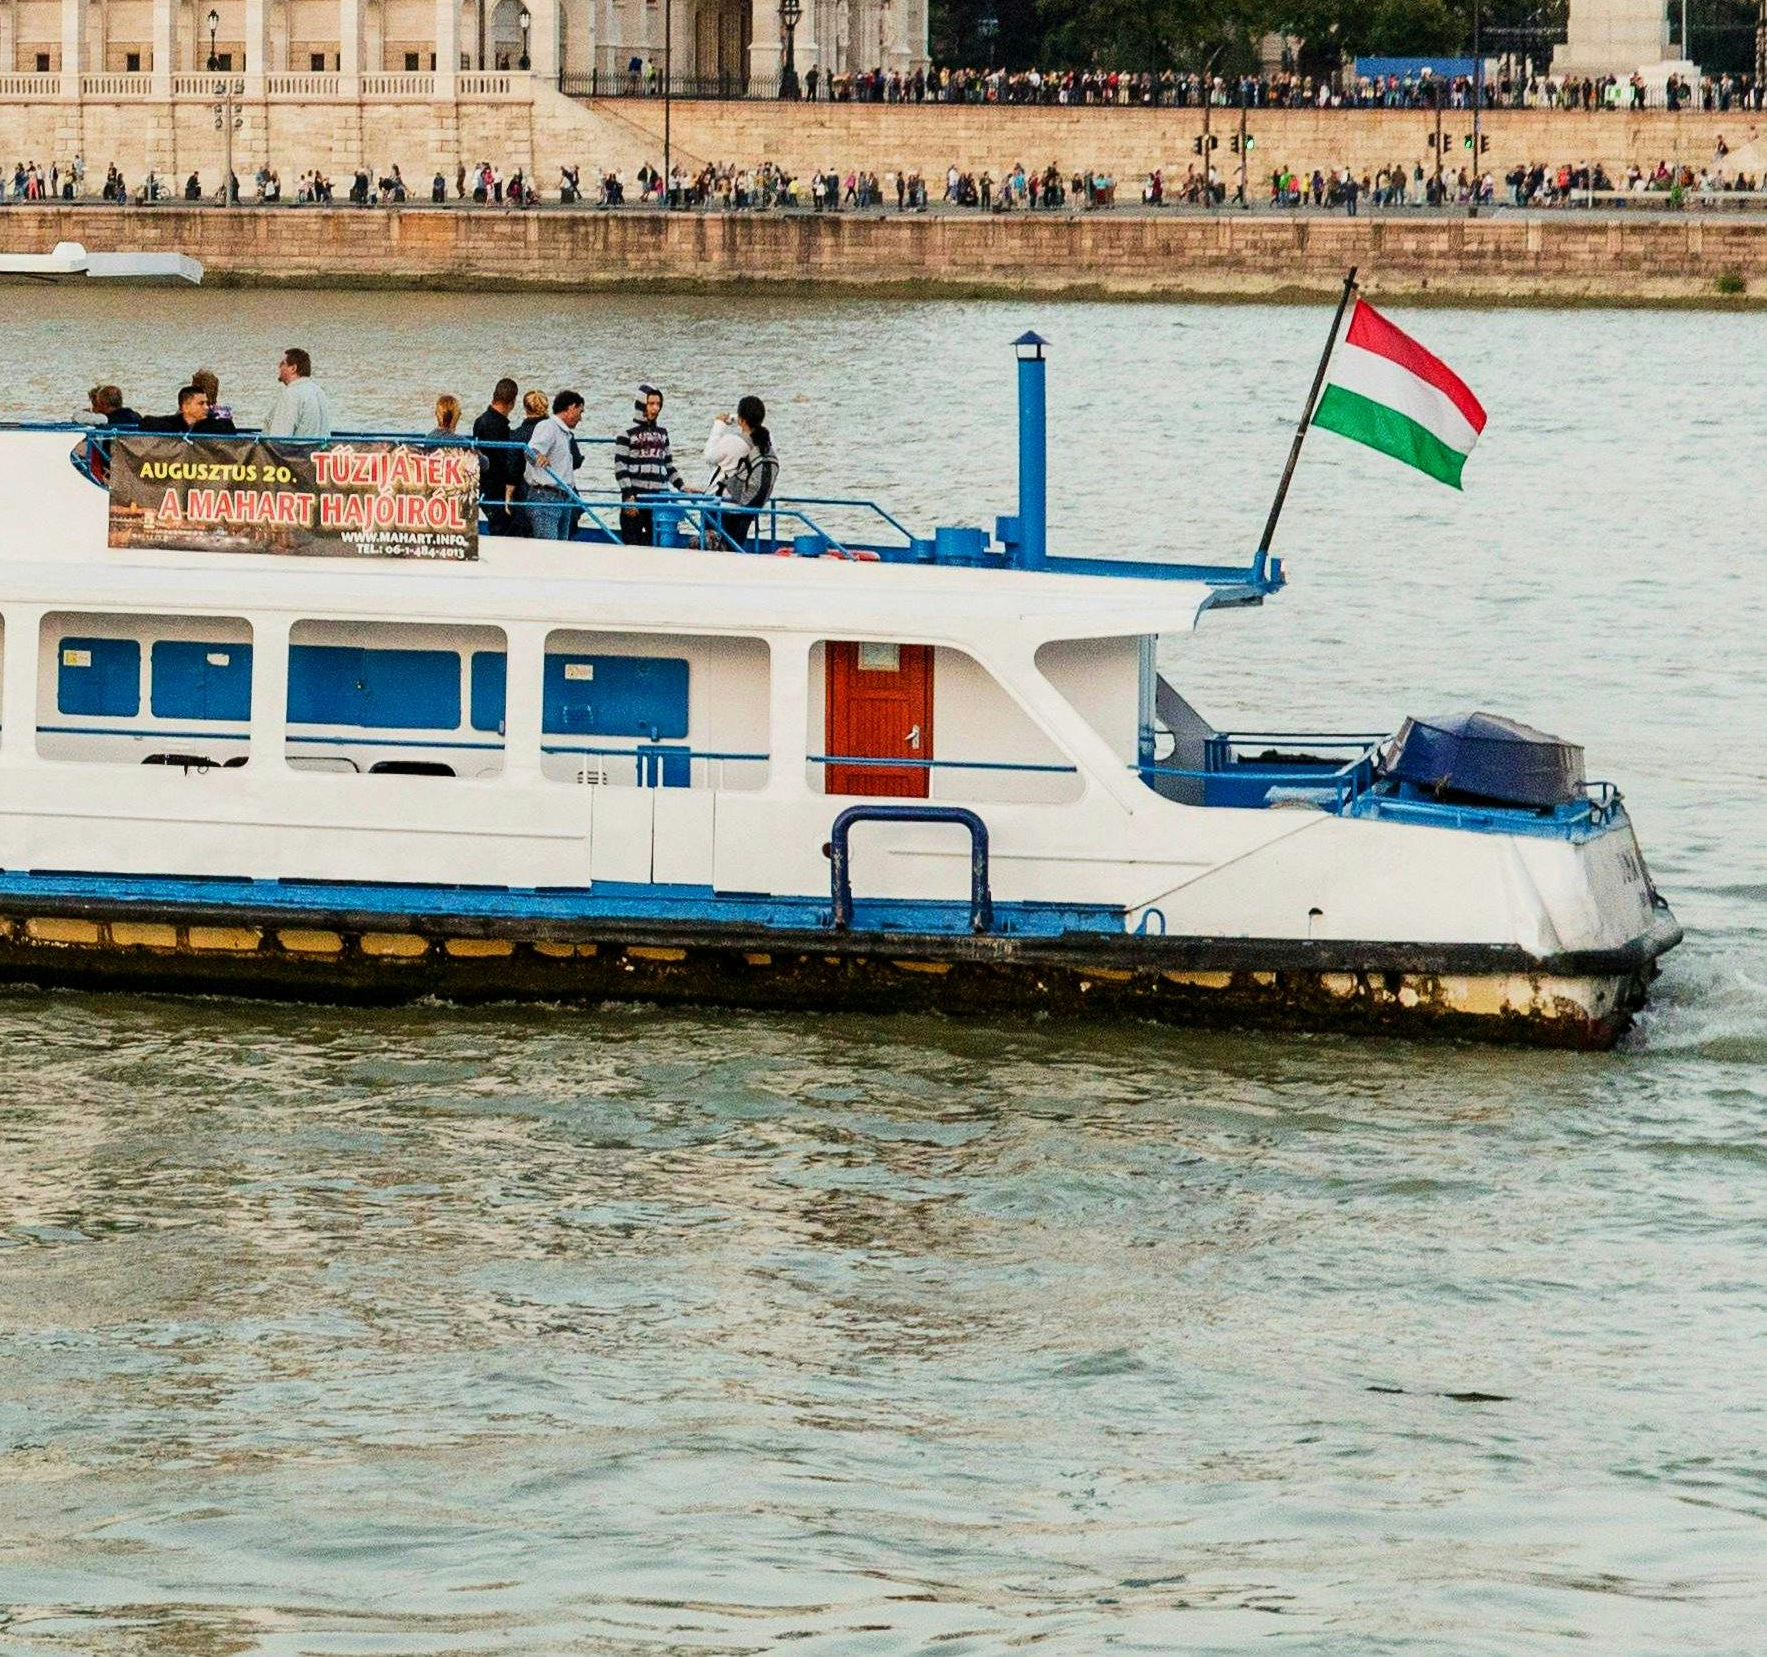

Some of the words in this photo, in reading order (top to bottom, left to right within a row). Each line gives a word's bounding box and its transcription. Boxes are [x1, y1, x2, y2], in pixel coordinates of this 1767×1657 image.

[140, 462, 258, 482] AUGUSZTUS
[262, 465, 298, 484] 20.
[311, 444, 465, 490] TŰZIJÁTÉK
[158, 488, 182, 520] A
[187, 488, 316, 525] MAHART
[320, 486, 466, 531] HAJÓIRÓL
[357, 544, 383, 555] TEL.:
[385, 546, 465, 559] 06-1-484-4013
